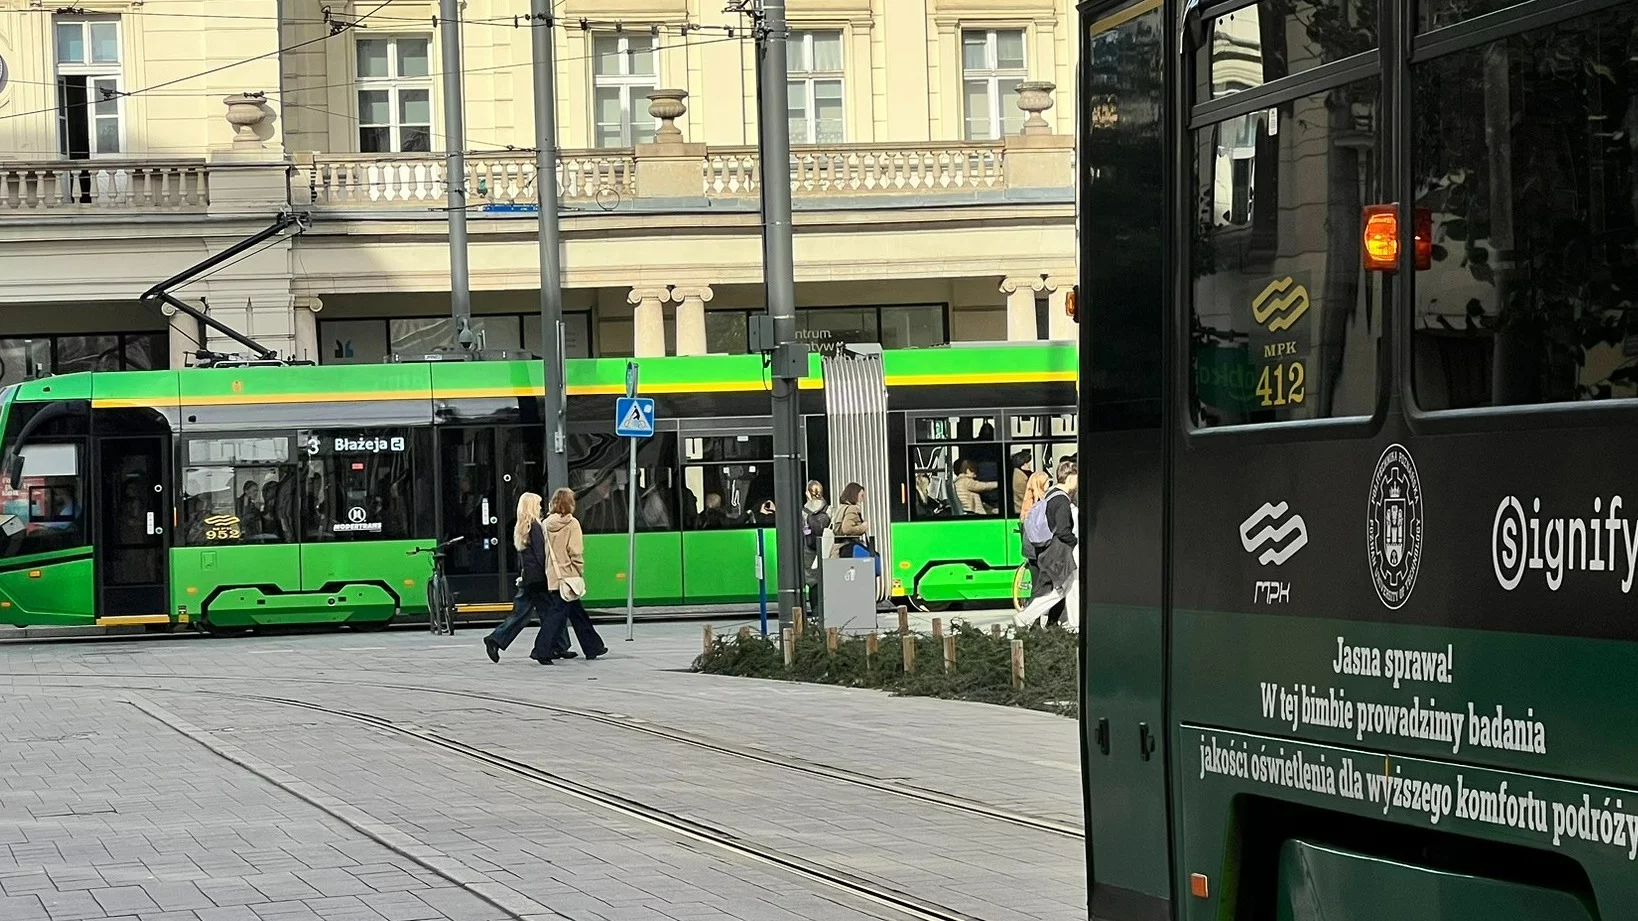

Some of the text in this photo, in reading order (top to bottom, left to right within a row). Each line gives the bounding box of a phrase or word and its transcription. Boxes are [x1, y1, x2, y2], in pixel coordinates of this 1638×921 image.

[795, 329, 832, 339] ntrum
[1263, 341, 1297, 358] MPK
[1255, 361, 1305, 406] 412
[307, 436, 388, 455] 3 Błażeja
[205, 530, 241, 540] 952
[1254, 581, 1290, 604] MPK
[1333, 636, 1453, 688] Jasna sprawa!
[1260, 682, 1546, 754] W tej bimbie prowadzimy badania
[1200, 734, 1638, 860] jakości oświetlenia dla wyższego komfortu podróży
